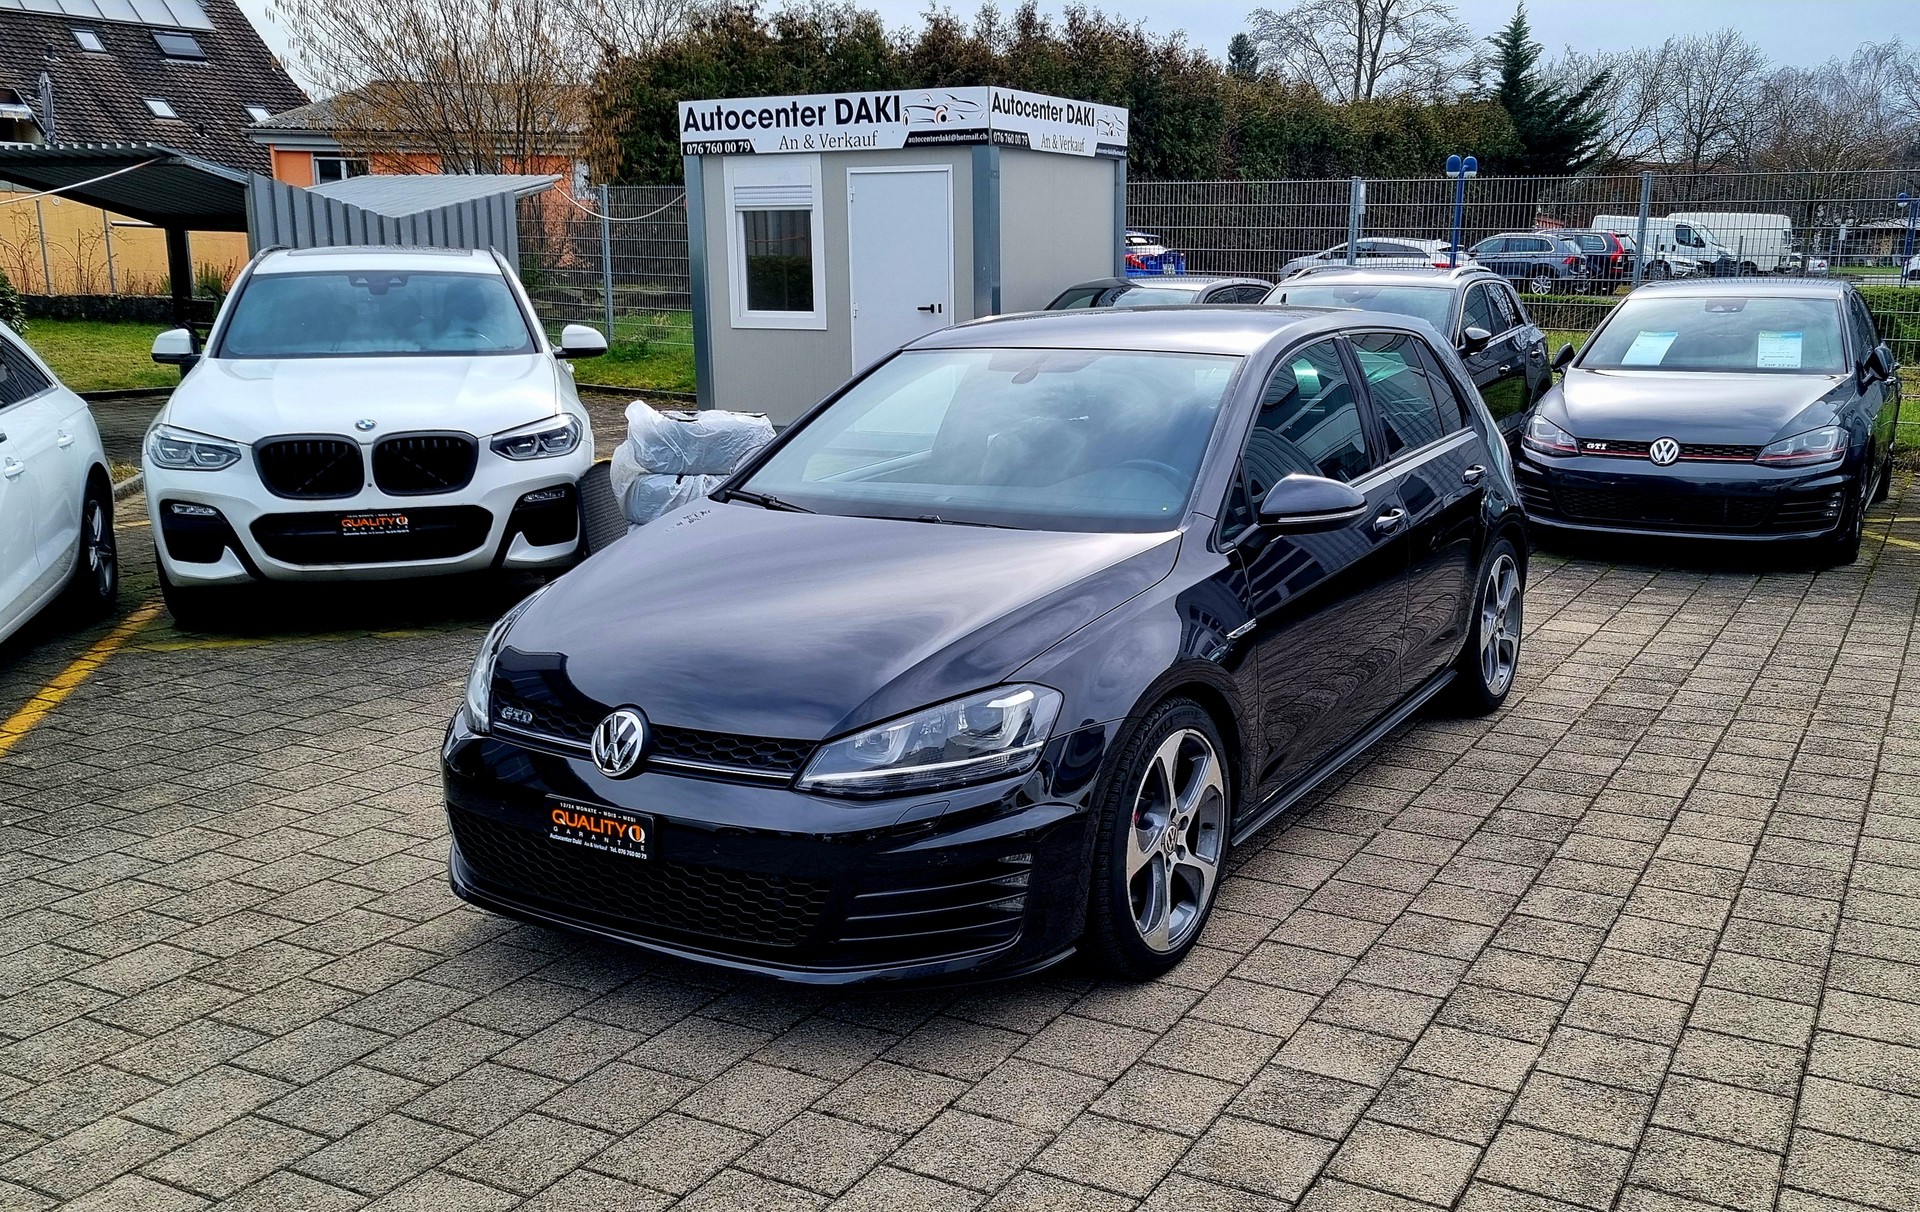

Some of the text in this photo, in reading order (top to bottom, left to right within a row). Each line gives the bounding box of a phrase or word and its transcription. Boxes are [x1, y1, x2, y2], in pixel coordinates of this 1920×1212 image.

[683, 95, 901, 133] Autocenter DAKI
[991, 91, 1095, 128] Autocenter DAKI
[686, 141, 751, 155] 076 760 00 79
[779, 130, 879, 150] An & Verkauf
[993, 132, 1028, 146] 076 760 00 79
[1041, 133, 1051, 148] An
[1052, 137, 1058, 149] &
[1059, 135, 1086, 153] Verkauf
[341, 517, 395, 528] QUALITY
[501, 706, 533, 725] GTD
[552, 809, 627, 838] QUALITY
[553, 826, 645, 852] GARANTIE
